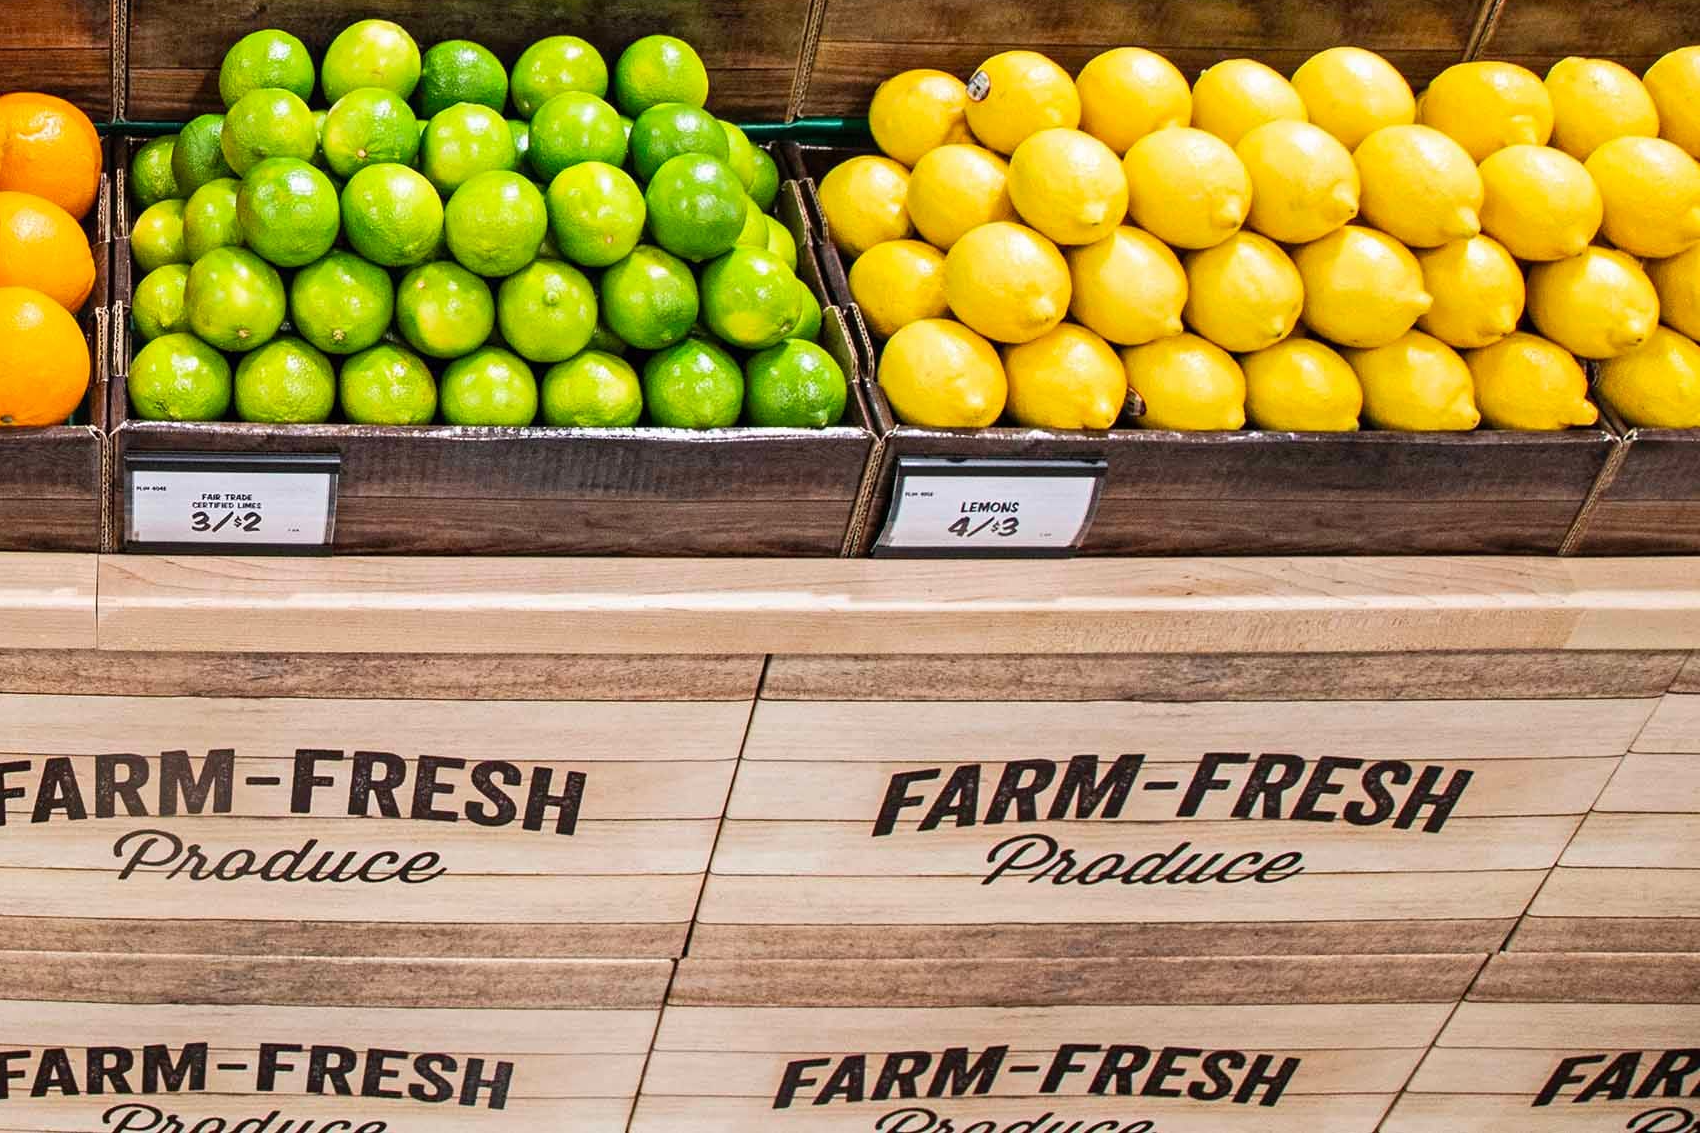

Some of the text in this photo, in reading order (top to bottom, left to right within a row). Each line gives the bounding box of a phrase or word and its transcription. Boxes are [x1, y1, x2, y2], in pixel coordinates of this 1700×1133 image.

[191, 511, 262, 533] 3/$2
[947, 516, 1020, 537] 4/$3
[960, 501, 1020, 513] LEMONS
[872, 752, 1474, 833] FARM-FRESH
[112, 829, 448, 884] Produce
[980, 833, 1305, 885] Produce
[772, 1044, 1301, 1107] FARM-FRESH
[1530, 1048, 1700, 1107] FAR
